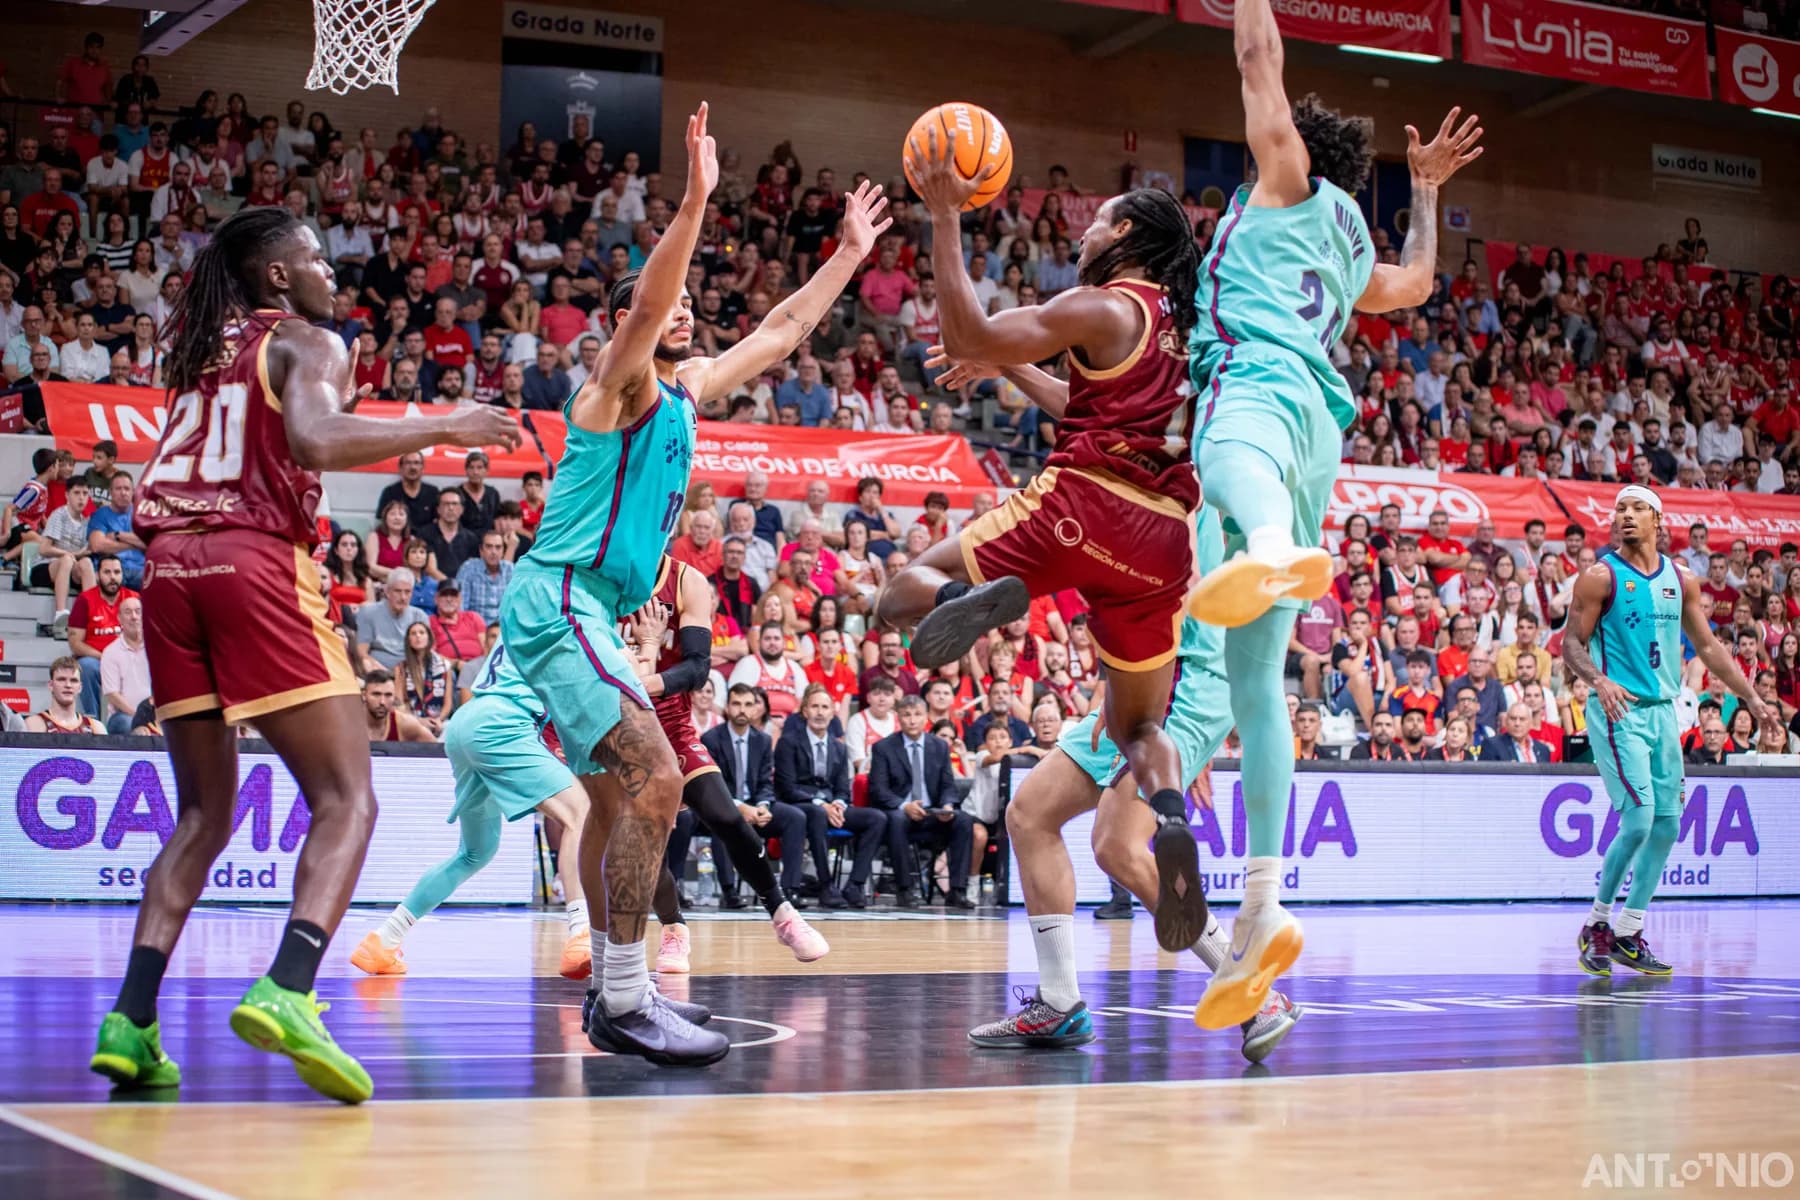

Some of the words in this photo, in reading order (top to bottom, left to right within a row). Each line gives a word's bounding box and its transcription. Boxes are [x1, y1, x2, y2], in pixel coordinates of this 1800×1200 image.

[511, 10, 585, 34] Grada
[595, 19, 656, 42] Norte
[1337, 6, 1361, 25] DE
[1366, 11, 1433, 32] MURCIA
[1482, 3, 1613, 64] Lunia
[1715, 160, 1757, 179] Norte
[143, 383, 248, 486] 20
[689, 453, 801, 476] REGIÓN
[803, 457, 844, 478] DE
[849, 461, 961, 483] MURCIA
[155, 566, 188, 579] REGIÓN
[188, 567, 199, 578] DE
[1082, 543, 1116, 567] REGIÓN
[1114, 561, 1129, 573] DE
[476, 644, 505, 690] 8
[1649, 641, 1661, 669] 5
